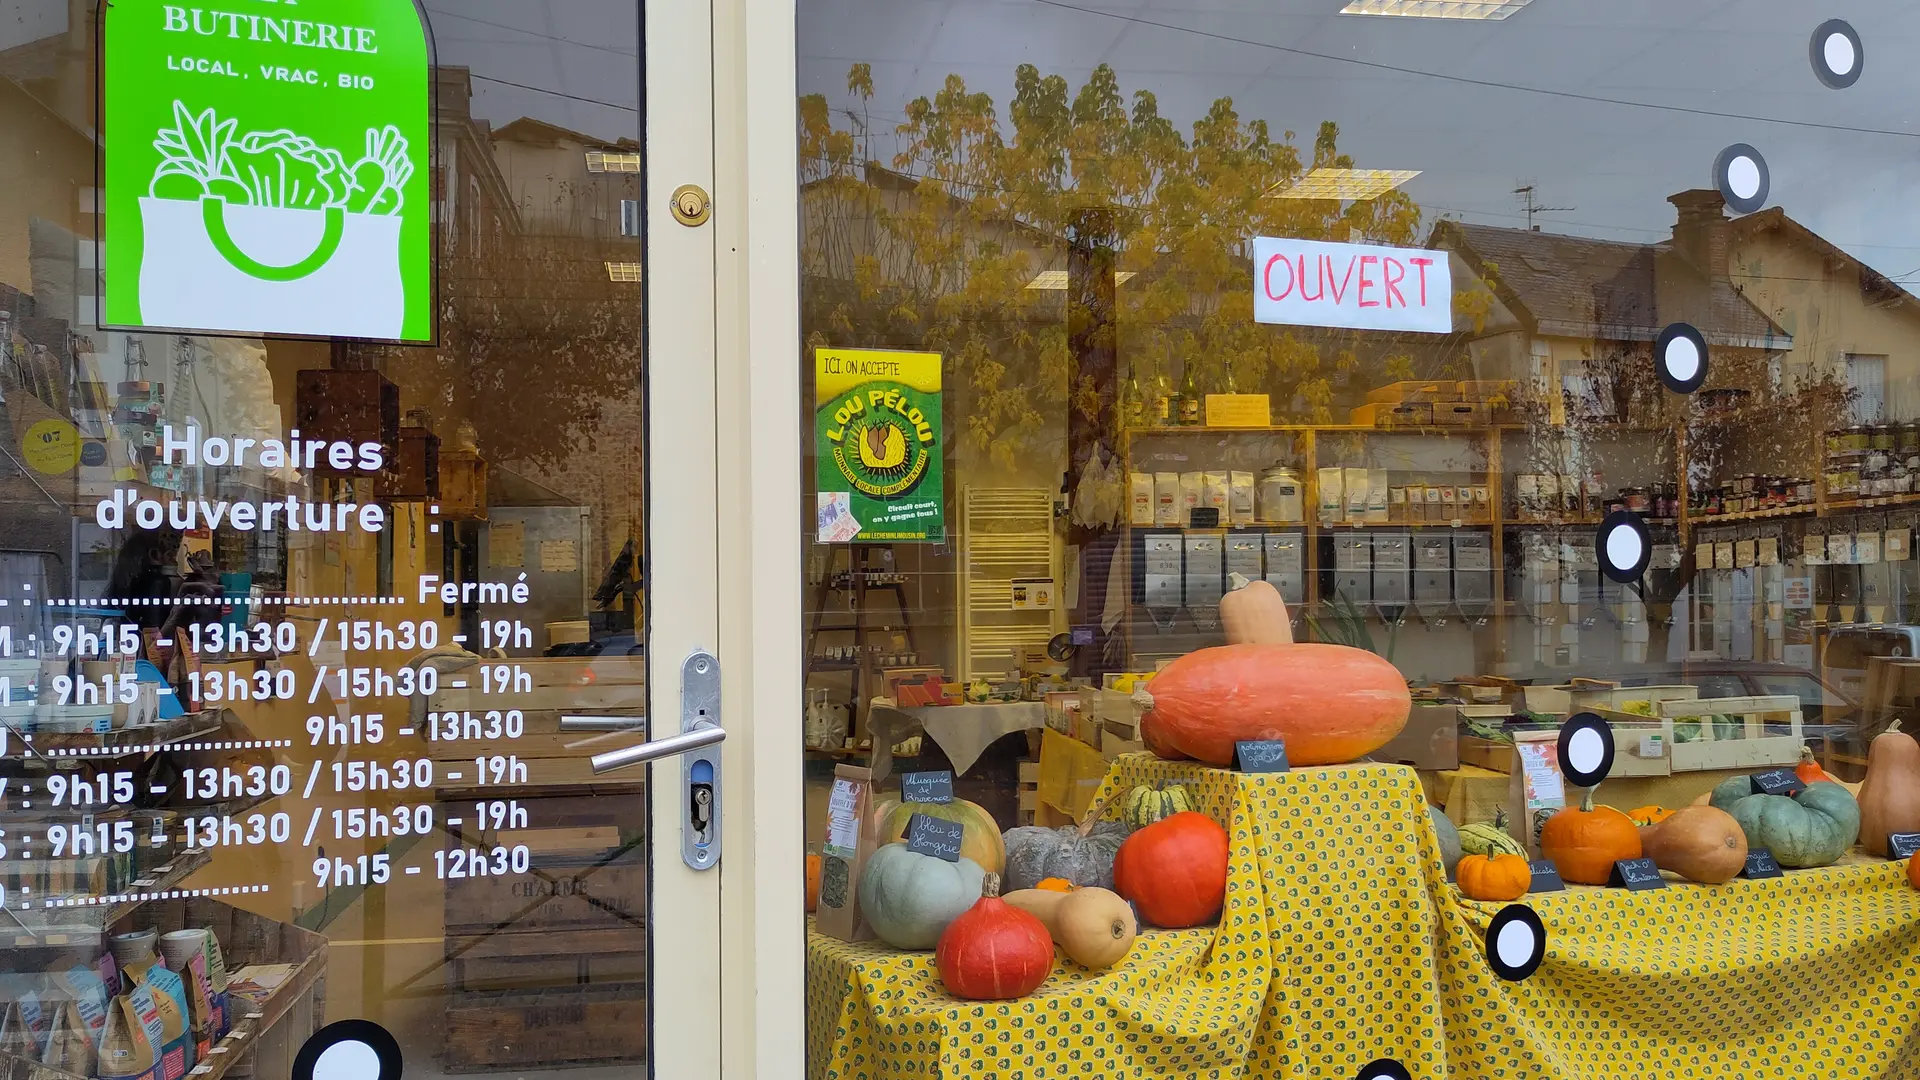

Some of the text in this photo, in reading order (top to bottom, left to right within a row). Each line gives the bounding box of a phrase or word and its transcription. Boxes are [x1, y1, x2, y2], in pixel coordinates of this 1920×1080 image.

[162, 5, 378, 54] BUTINERIE
[338, 73, 374, 90] BIO
[1264, 252, 1434, 309] OUVERT
[846, 360, 858, 375] ON
[860, 361, 900, 376] ACCEPTE
[826, 388, 933, 443] LOU PÉLOU
[163, 425, 383, 470] Horaires
[832, 447, 857, 484] MONNAIE
[856, 480, 881, 494] LOCALE
[884, 515, 890, 523] y
[891, 511, 916, 522] gagne
[917, 510, 934, 518] tous
[887, 500, 938, 513] Circuit court,
[419, 572, 529, 604] Fermé
[52, 624, 140, 656] 9h15
[188, 622, 296, 653] 13h30
[337, 620, 438, 651] 15h30
[480, 620, 532, 649] 19h
[52, 673, 139, 706] 9h15
[188, 669, 295, 702] 13h30
[337, 666, 437, 698] 15h30
[480, 665, 532, 694] 19h
[306, 714, 384, 746] 9h15
[428, 710, 523, 741] 13h30
[46, 771, 134, 807] 9h15
[183, 764, 290, 799] 13h30
[332, 758, 433, 792] 15h30
[475, 755, 527, 785] 19h
[905, 772, 951, 788] Musquée
[917, 784, 930, 795] de
[905, 792, 951, 802] Provence
[47, 821, 134, 857] 9h15
[184, 812, 290, 848] 13h30
[332, 804, 433, 839] 15h30
[476, 800, 528, 831] 19h
[918, 814, 961, 840] bleu de
[913, 832, 961, 856] Hongrie
[1745, 852, 1770, 863] ongue
[312, 853, 390, 888] 9h15
[434, 845, 529, 879] 12h30
[1619, 860, 1641, 877] Jack
